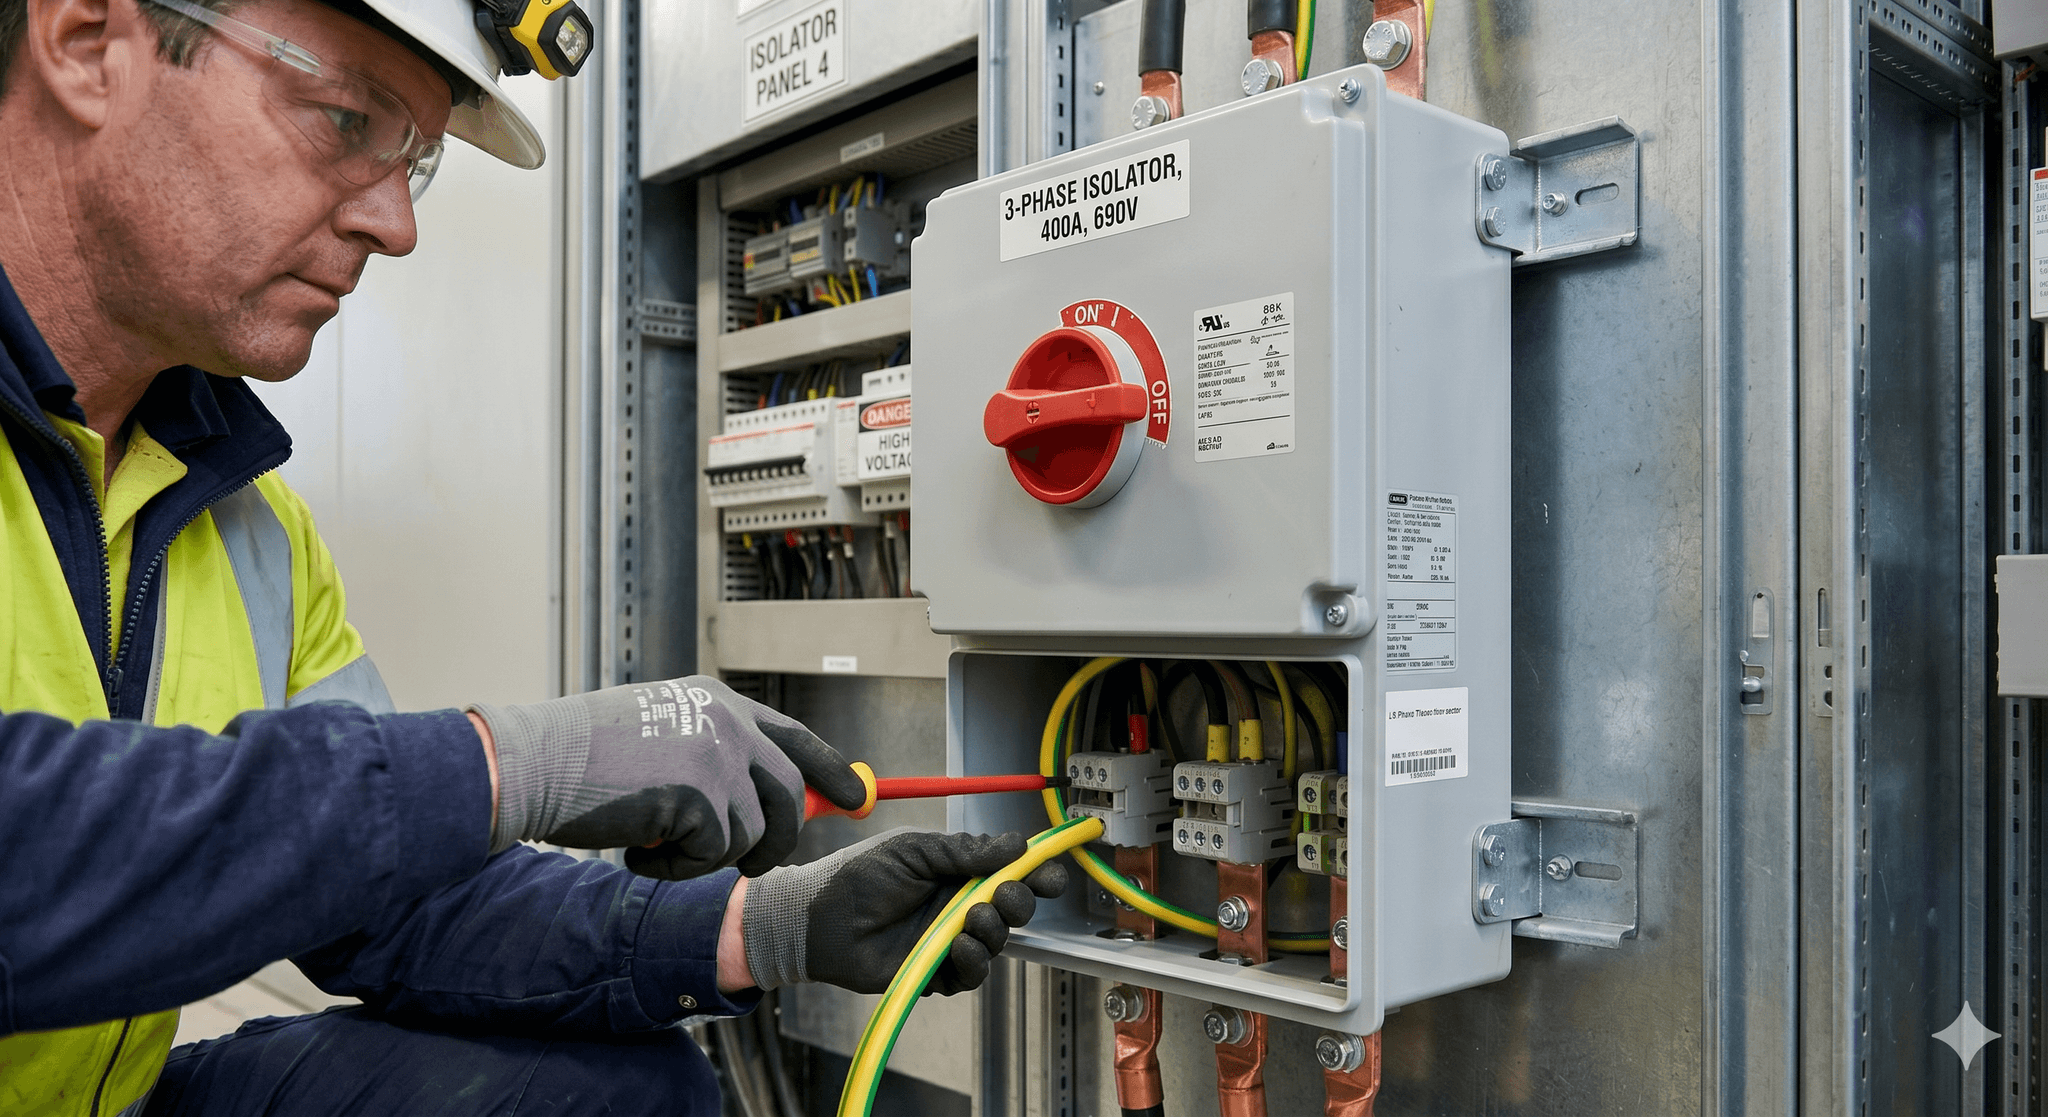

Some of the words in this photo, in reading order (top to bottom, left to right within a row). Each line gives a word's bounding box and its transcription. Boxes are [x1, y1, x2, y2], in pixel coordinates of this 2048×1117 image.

[751, 8, 837, 72] ISOLATOR
[757, 60, 812, 105] PANEL
[818, 50, 829, 78] 4
[1004, 179, 1078, 221] 3-PHASE
[1083, 153, 1182, 201] ISOLATOR,
[1040, 211, 1088, 242] 400A,
[1094, 195, 1139, 230] 690V
[1263, 302, 1282, 315] 88K
[867, 404, 911, 425] DANGE
[1151, 380, 1167, 425] OFF
[865, 452, 911, 471] VOLTA
[879, 432, 910, 451] HIGH
